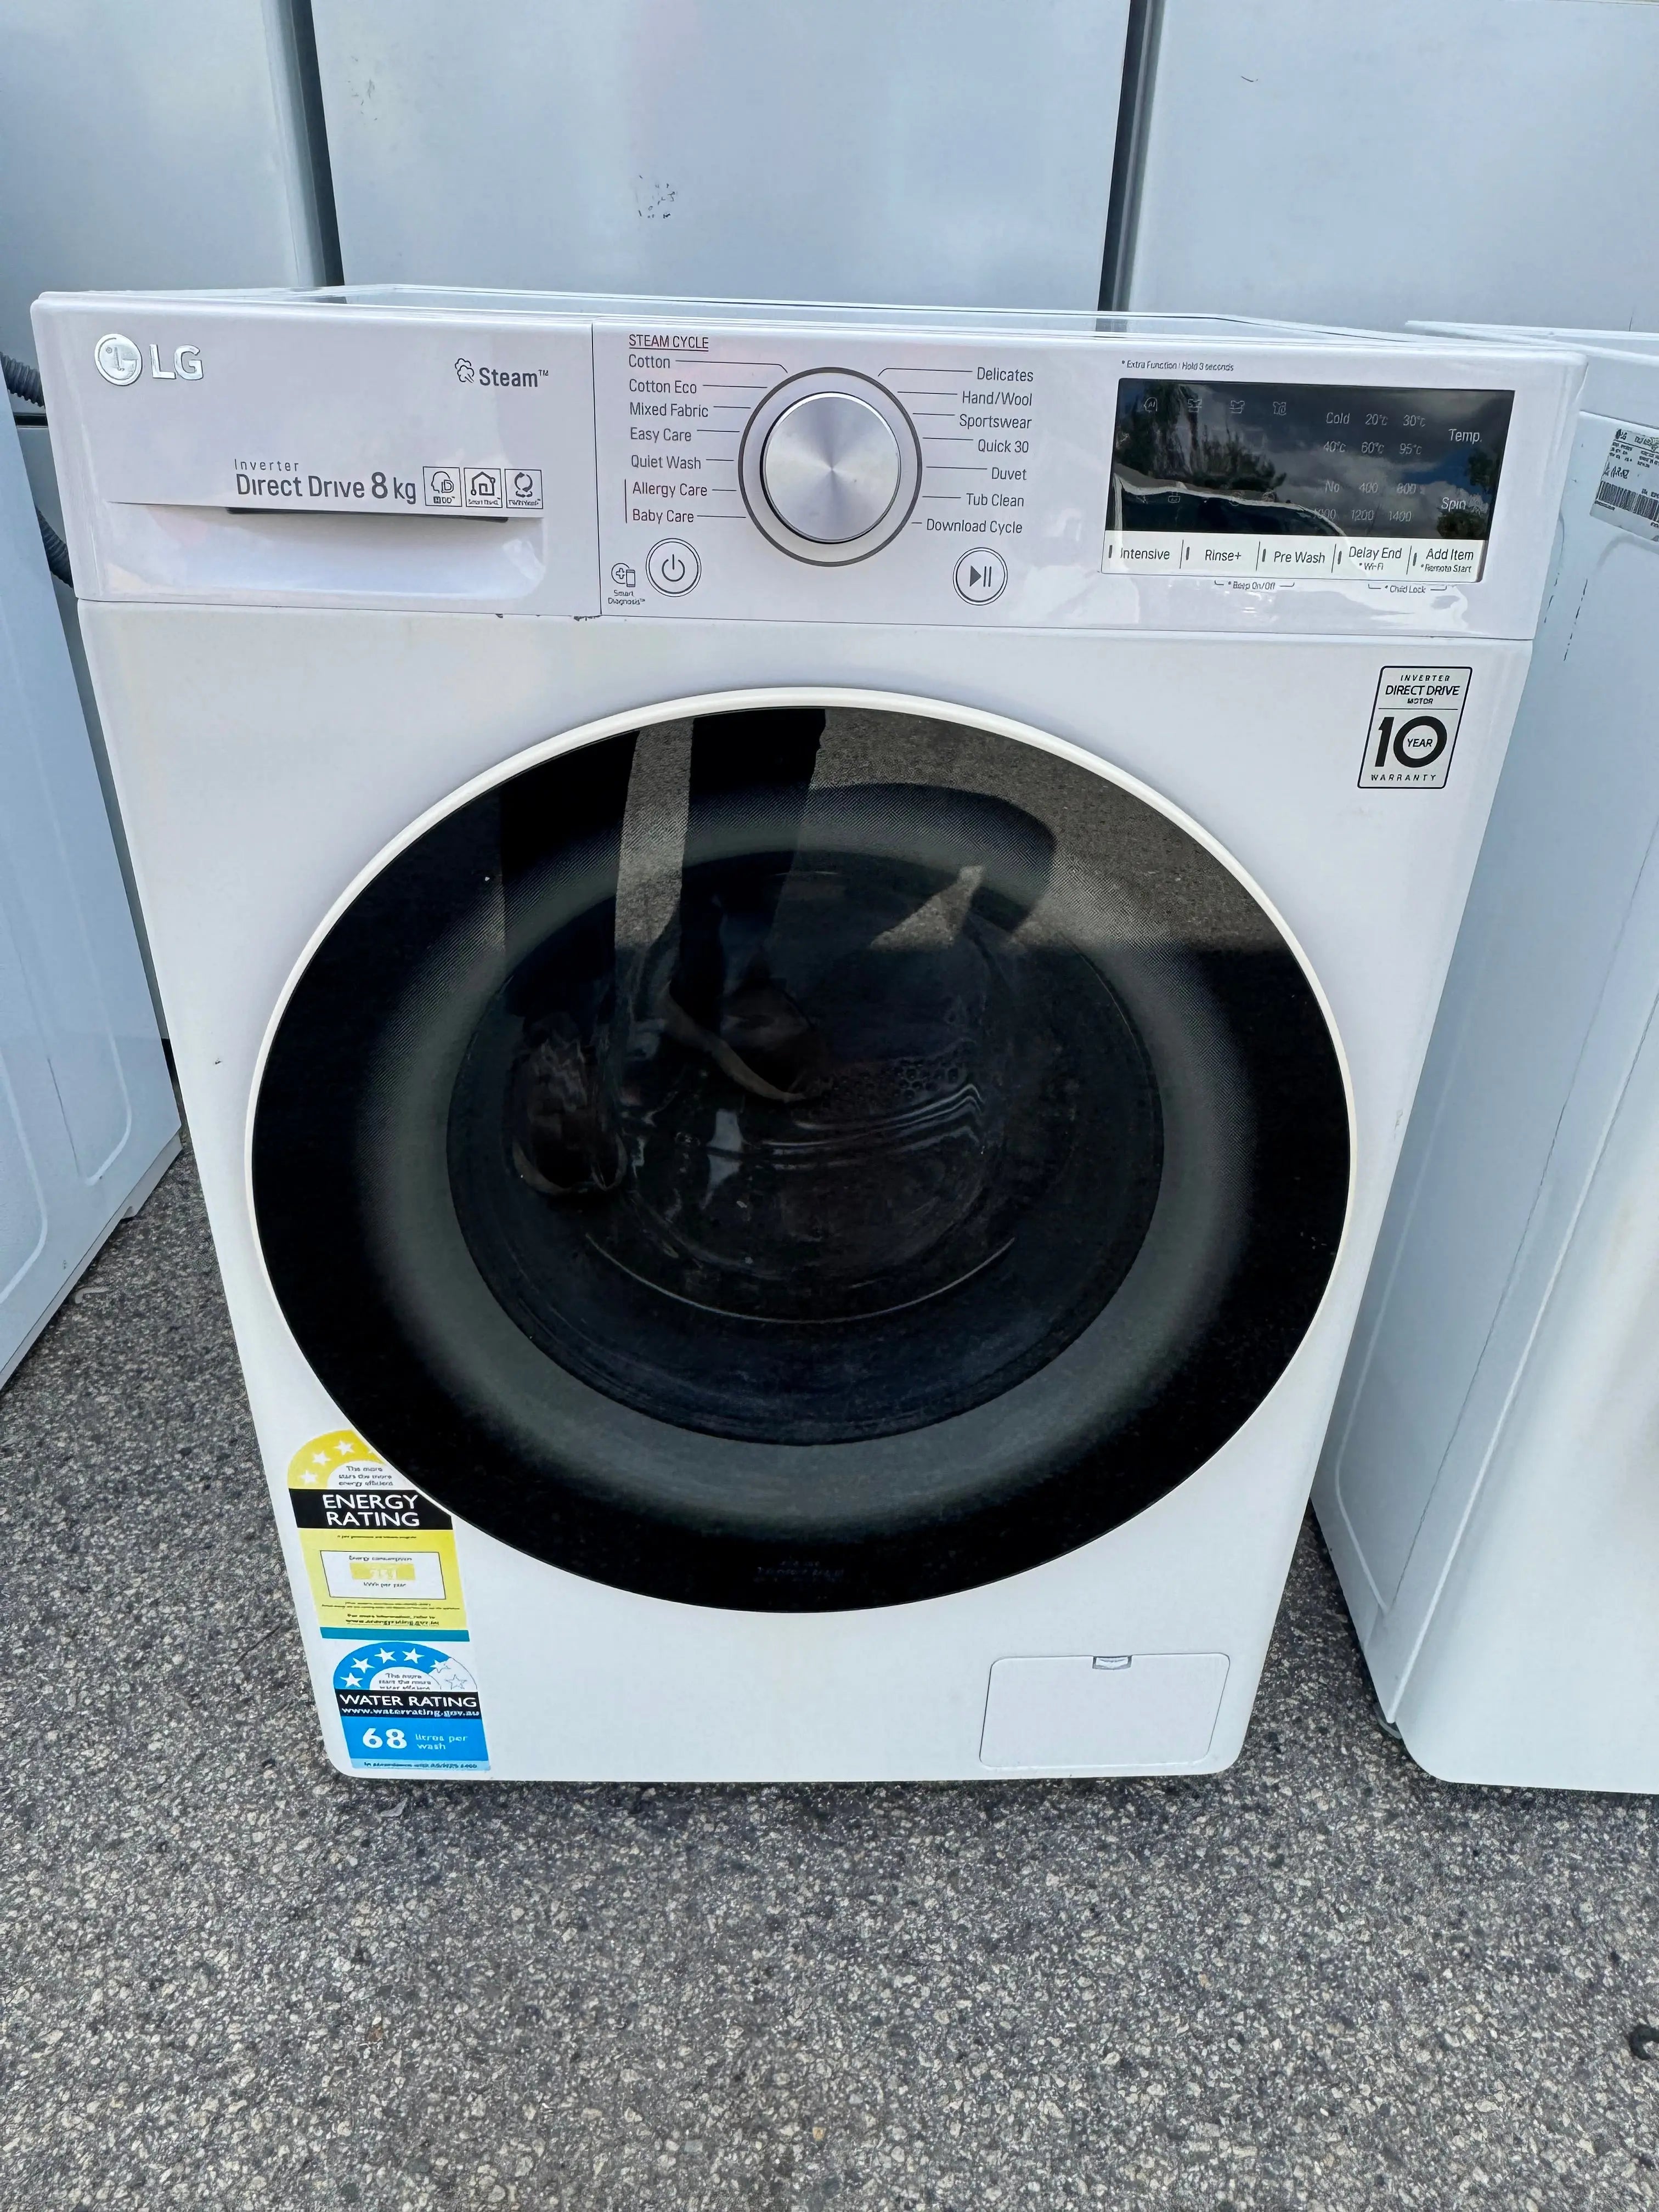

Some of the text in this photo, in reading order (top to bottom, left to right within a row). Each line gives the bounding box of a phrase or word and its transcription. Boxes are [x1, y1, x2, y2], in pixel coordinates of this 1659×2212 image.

[629, 334, 709, 348] STEAM CYCLE
[149, 343, 204, 380] LG
[629, 354, 670, 368] Cotton
[977, 366, 1034, 382] Delicates
[629, 379, 697, 393] Cotton Eco
[962, 390, 1032, 406] Hand/Wool
[630, 402, 708, 417] Mixed Fabric
[960, 414, 1032, 429] Sportswear
[1326, 411, 1350, 425] Cold
[630, 427, 691, 443] Easy Care
[1448, 428, 1482, 445] Temp.
[978, 439, 1029, 453] Quick 30
[234, 459, 299, 471] Inverter
[631, 455, 701, 469] Quiet Wash
[991, 467, 1027, 481] Duvet
[236, 471, 416, 504] Direct Drive 8 kg
[633, 481, 707, 498] Allergy Care
[1325, 479, 1340, 493] No
[1359, 482, 1378, 494] 400
[966, 493, 1024, 507] Tub Clean
[1441, 496, 1466, 512] Spin
[633, 509, 694, 524] Baby Care
[1351, 509, 1374, 521] 1200
[1389, 511, 1412, 522] 1400
[927, 518, 1023, 535] Download Cycle
[1120, 547, 1170, 560] Intensive
[1205, 549, 1242, 561] Rinse+
[1273, 551, 1325, 564] Pre Wash
[1348, 546, 1402, 560] Delay End
[1426, 548, 1474, 561] Add Item
[1385, 685, 1460, 696] DIRECT DRIVE
[1374, 715, 1448, 768] 10
[1407, 738, 1433, 747] YEAR
[322, 1494, 419, 1509] ENERGY
[326, 1511, 420, 1527] RATING
[339, 1694, 477, 1708] WATER RATING
[362, 1728, 407, 1750] 68
